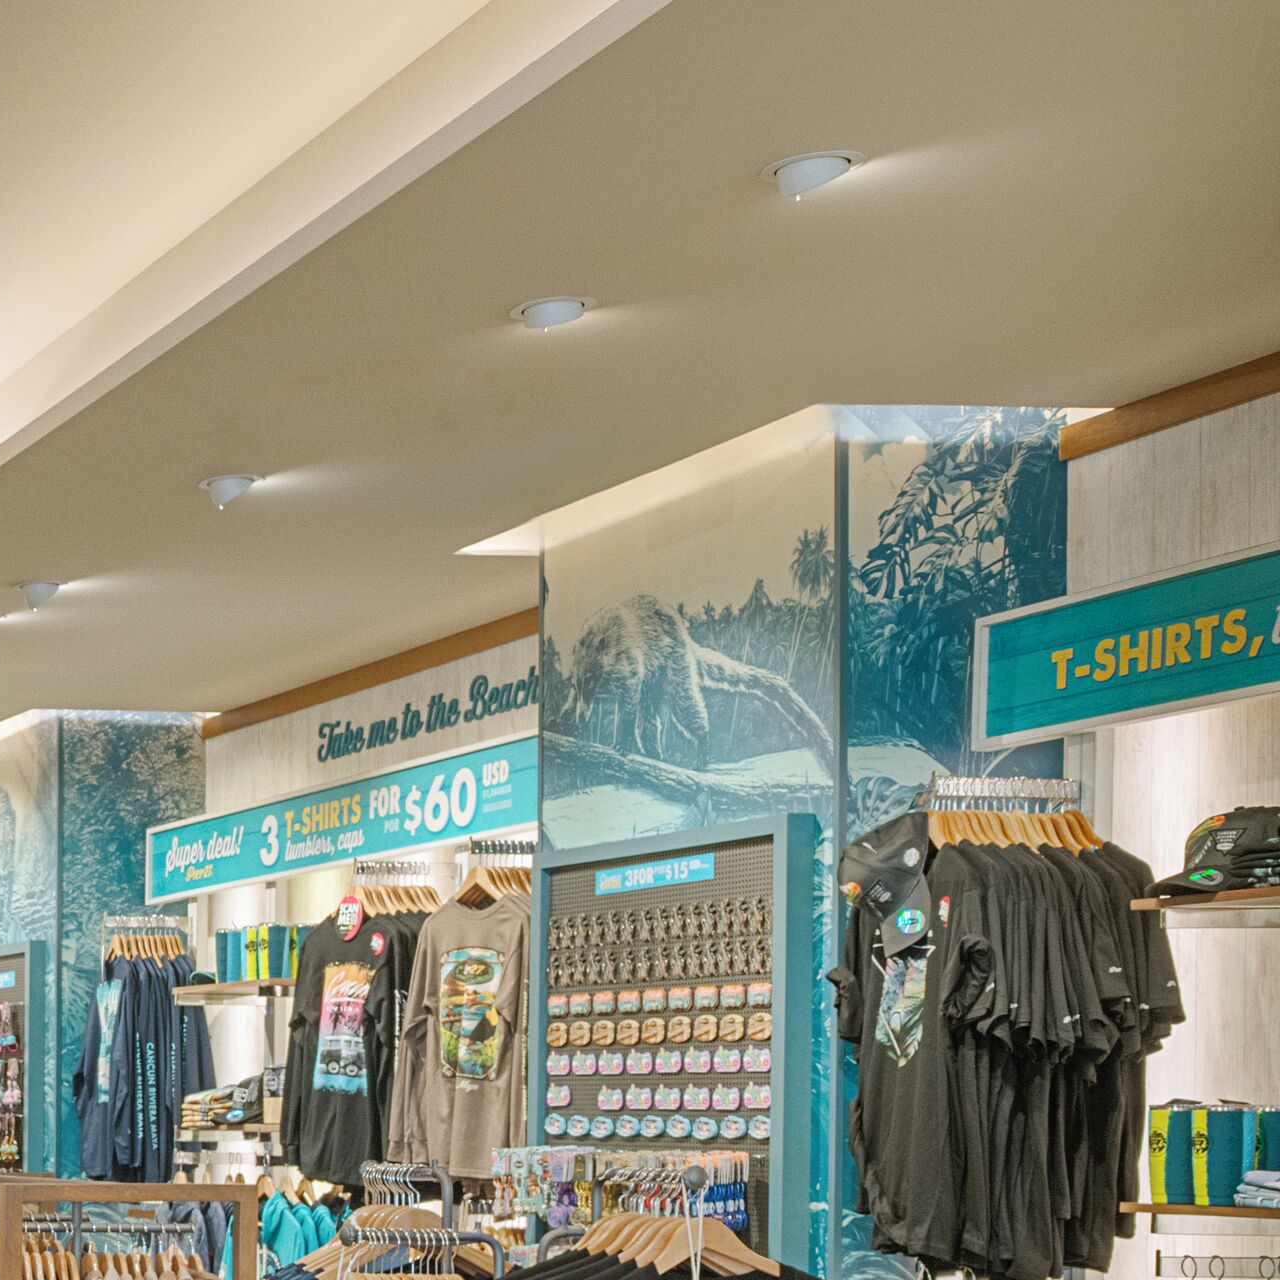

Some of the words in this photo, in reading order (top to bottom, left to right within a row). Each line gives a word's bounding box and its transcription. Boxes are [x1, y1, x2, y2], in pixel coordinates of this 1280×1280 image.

[1051, 608, 1264, 689] T-SHIRTS,
[318, 721, 364, 762] Take
[367, 715, 399, 750] me
[400, 703, 424, 740] to
[426, 693, 460, 734] the
[463, 666, 539, 722] Beach
[259, 814, 278, 867] 3
[285, 793, 362, 838] T-SHIRTS
[369, 784, 400, 819] FOR
[404, 767, 476, 836] $60
[482, 760, 509, 787] USD
[165, 835, 205, 876] Super
[206, 825, 245, 862] deal!
[284, 835, 336, 862] tumblers,
[337, 828, 365, 856] caps
[339, 902, 359, 914] SCAN
[146, 1042, 156, 1084] CANCUN
[148, 1087, 158, 1122] RIVIERA
[150, 1123, 159, 1150] MAYA
